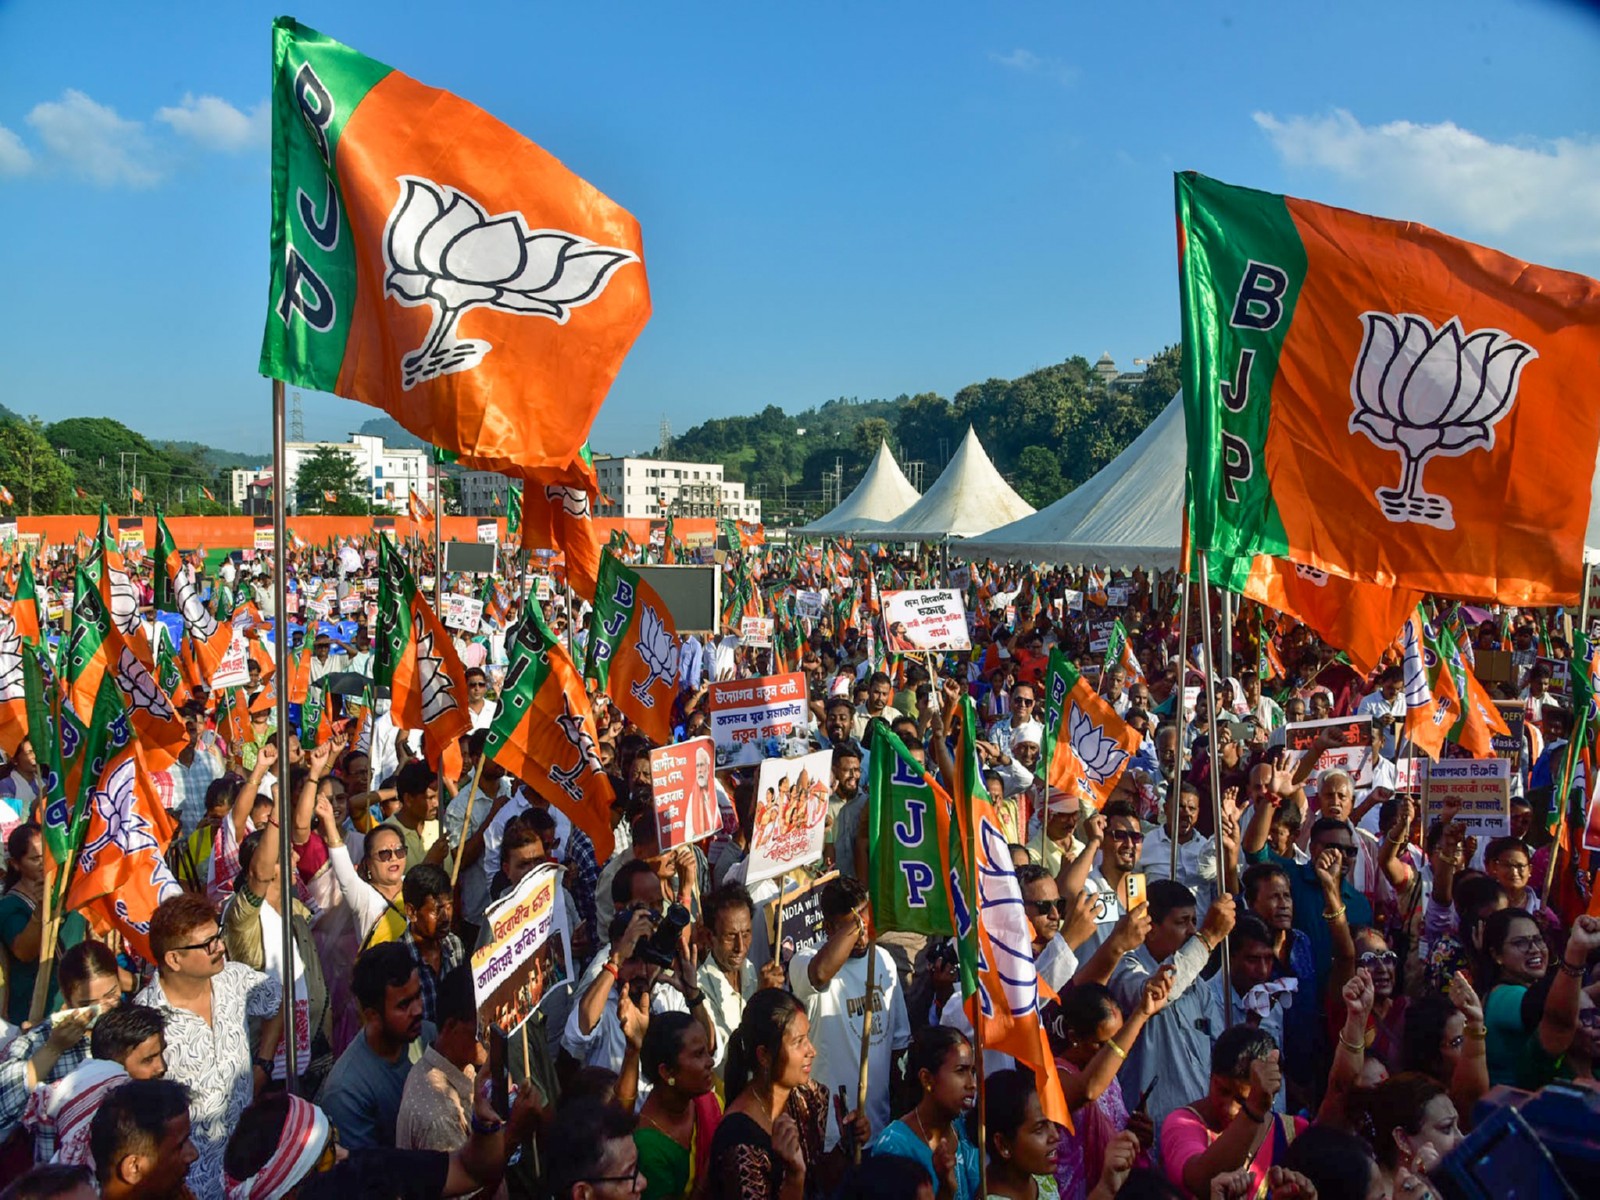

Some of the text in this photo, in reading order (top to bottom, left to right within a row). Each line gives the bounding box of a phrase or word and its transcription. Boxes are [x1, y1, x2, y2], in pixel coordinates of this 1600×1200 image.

[1220, 259, 1289, 503] BJP
[592, 576, 634, 668] BJP
[756, 685, 777, 702] নতুন
[1503, 711, 1524, 721] DEFY
[732, 728, 758, 744] নতুন
[1399, 771, 1416, 784] Pue
[781, 892, 820, 922] NDIA will
[804, 909, 825, 928] Rah
